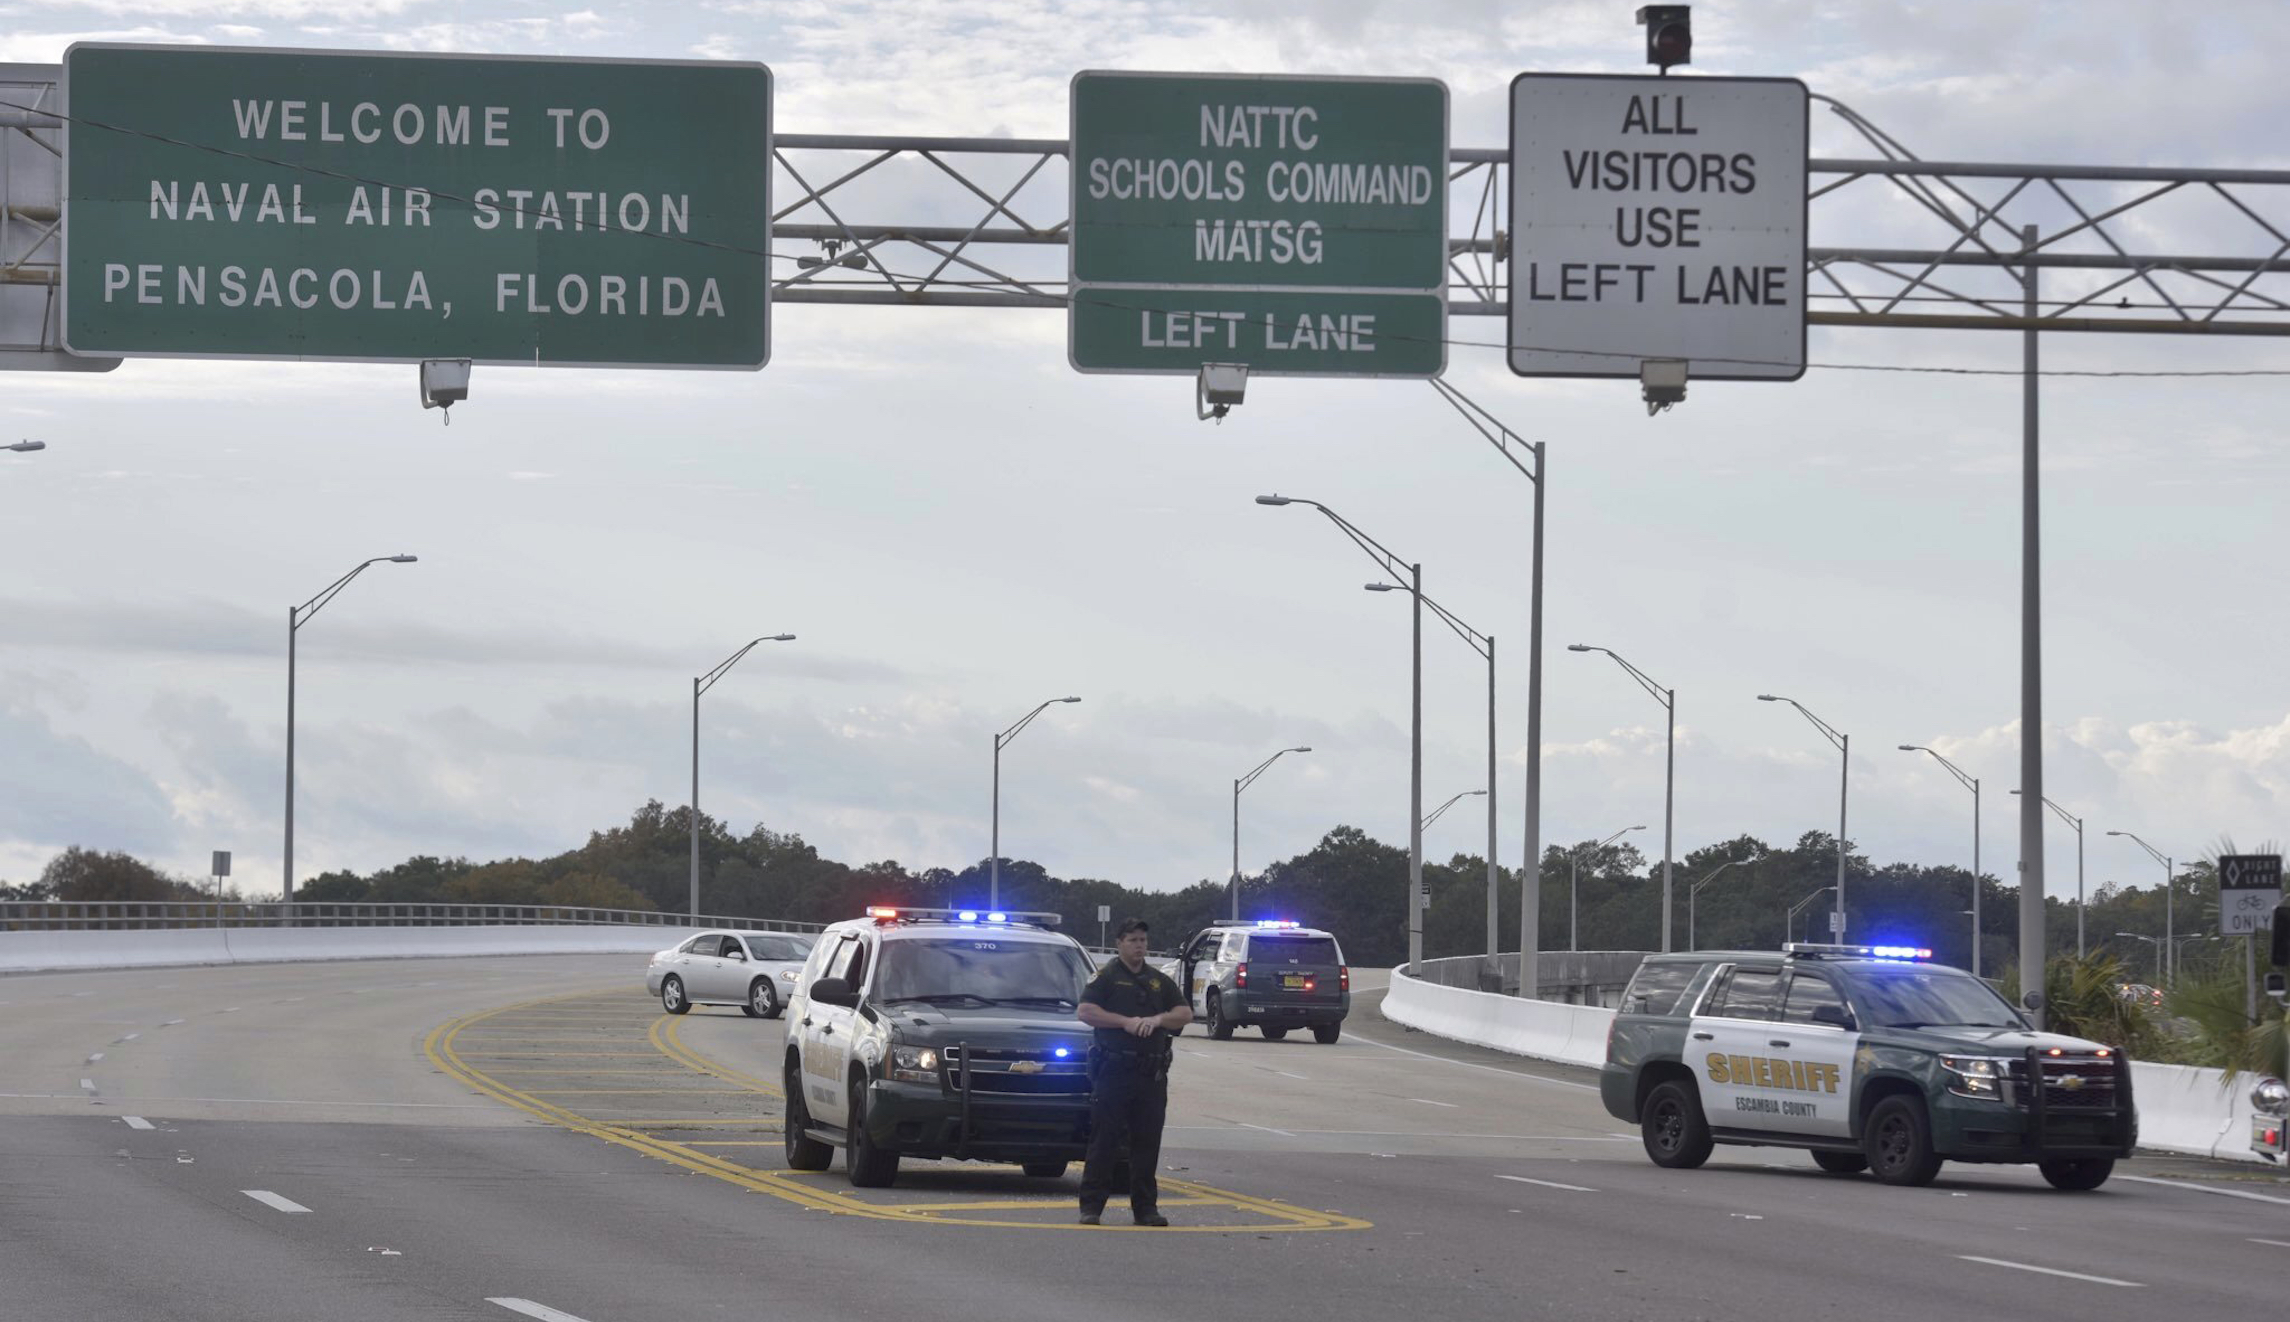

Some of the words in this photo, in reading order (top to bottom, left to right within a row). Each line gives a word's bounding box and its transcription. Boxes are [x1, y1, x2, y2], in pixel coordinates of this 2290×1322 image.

[232, 99, 510, 147] WELCOME
[546, 108, 610, 150] TO
[1200, 104, 1319, 151] NATTC
[1621, 94, 1698, 135] ALL
[1089, 157, 1245, 202] SCHOOLS
[1266, 160, 1432, 205] COMMAND
[1562, 149, 1756, 195] VISITORS
[150, 180, 317, 224] NAVAL
[345, 186, 431, 227] AIR
[472, 188, 689, 234] STATION
[1616, 206, 1701, 249] USE
[1195, 219, 1323, 265] MATSG
[104, 263, 451, 319] PENSACOLA,
[496, 272, 725, 317] FLORIDA
[1529, 262, 1656, 303] LEFT
[1677, 265, 1787, 306] LANE
[1142, 310, 1246, 349] LEFT
[1265, 312, 1376, 351] LANE
[2244, 860, 2277, 872] RIGHT
[2245, 873, 2276, 884] LANE
[1706, 1052, 1841, 1094] SHERIFF
[1735, 1096, 1780, 1114] ESCAMBIA
[1782, 1100, 1817, 1118] COUNTY
